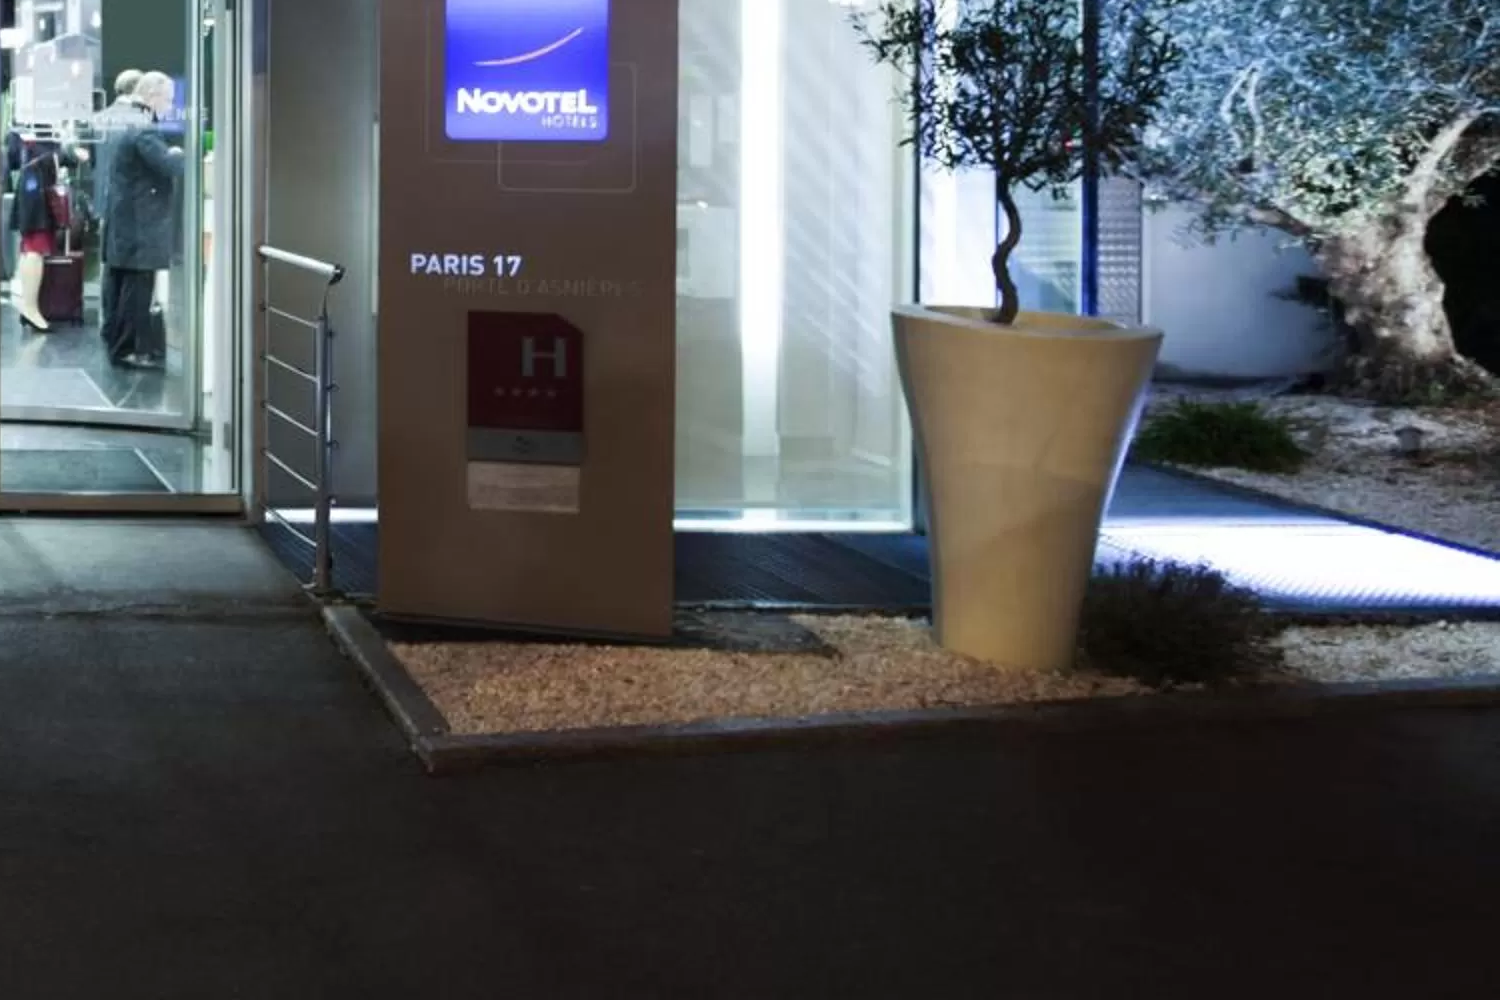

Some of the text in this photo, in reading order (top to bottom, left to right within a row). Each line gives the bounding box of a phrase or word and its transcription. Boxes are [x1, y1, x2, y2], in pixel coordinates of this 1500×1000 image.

[456, 87, 598, 114] NOVOTEL
[541, 115, 598, 129] HOTELS
[409, 252, 524, 278] PARIS 17
[520, 334, 568, 378] H
